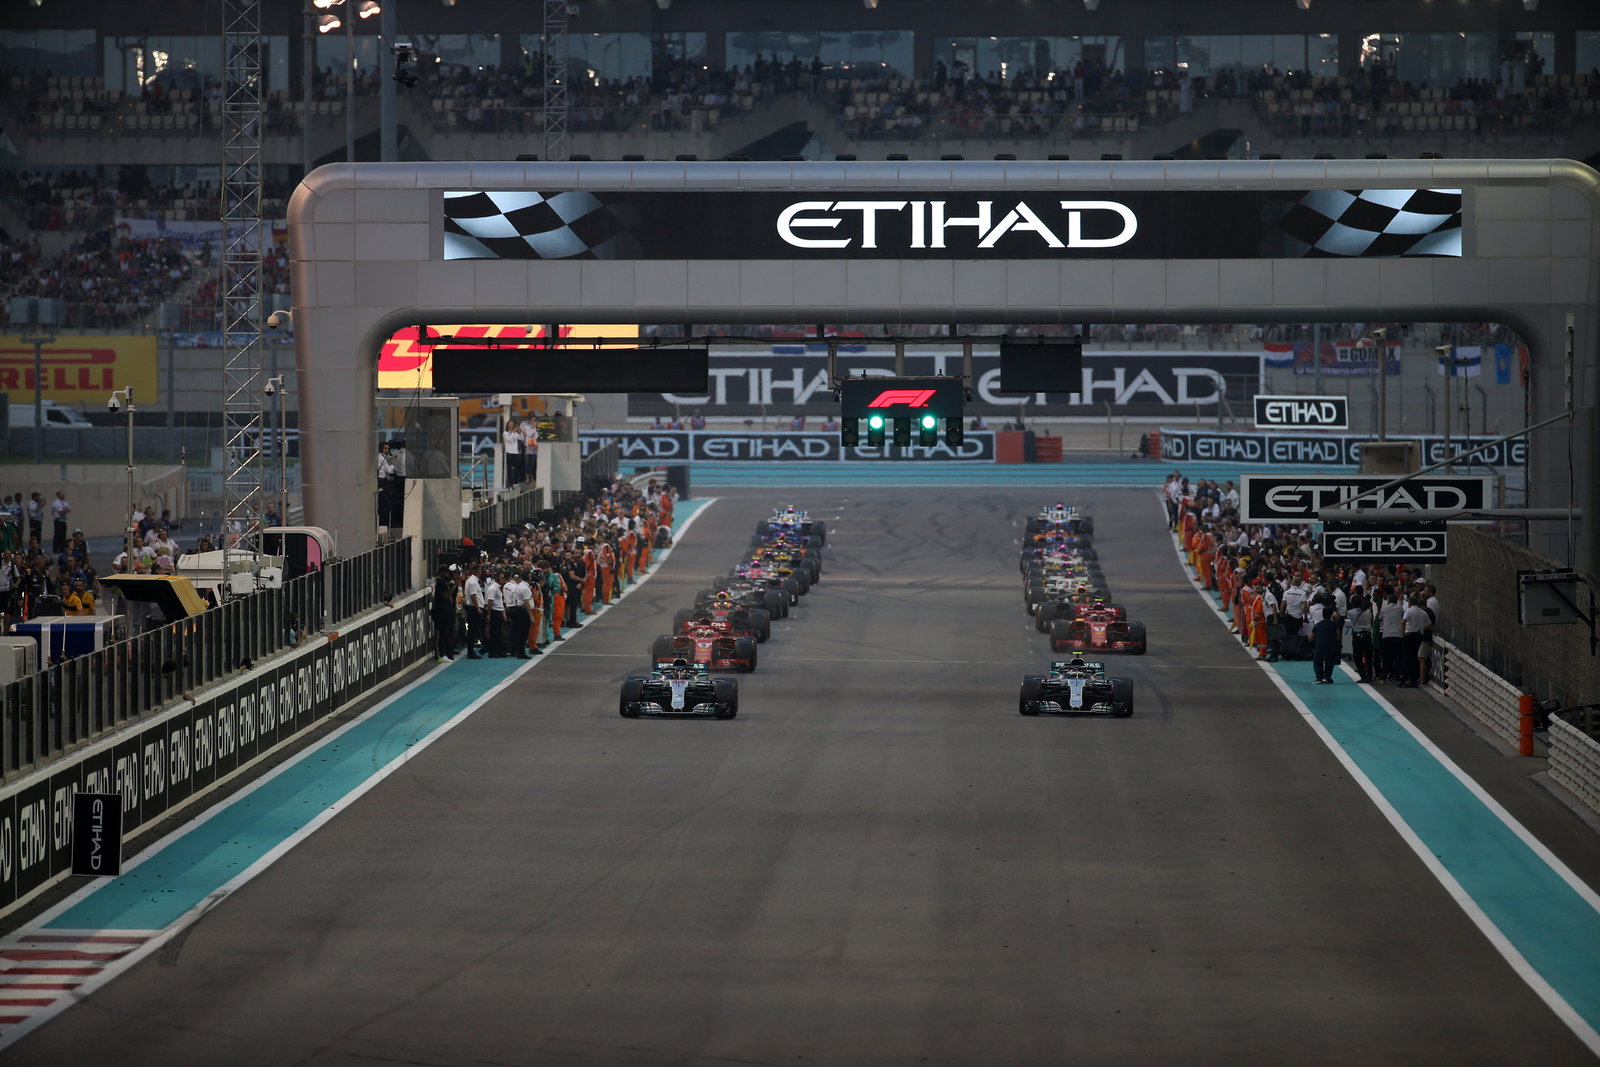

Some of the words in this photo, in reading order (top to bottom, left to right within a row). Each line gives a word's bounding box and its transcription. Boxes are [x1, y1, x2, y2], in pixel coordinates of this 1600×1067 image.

[777, 200, 1138, 249] ETIHAD
[1339, 346, 1396, 361] #GOMX
[1265, 401, 1337, 423] ETIHAD
[703, 440, 831, 458] ETIHAD
[1196, 438, 1261, 459] ETIHAD
[1272, 440, 1339, 461] ETIHAD
[1264, 485, 1467, 512] ETIHAD
[1333, 537, 1437, 552] ETIHAD
[20, 798, 46, 871] ETIHAD
[91, 798, 104, 870] ETIHAD
